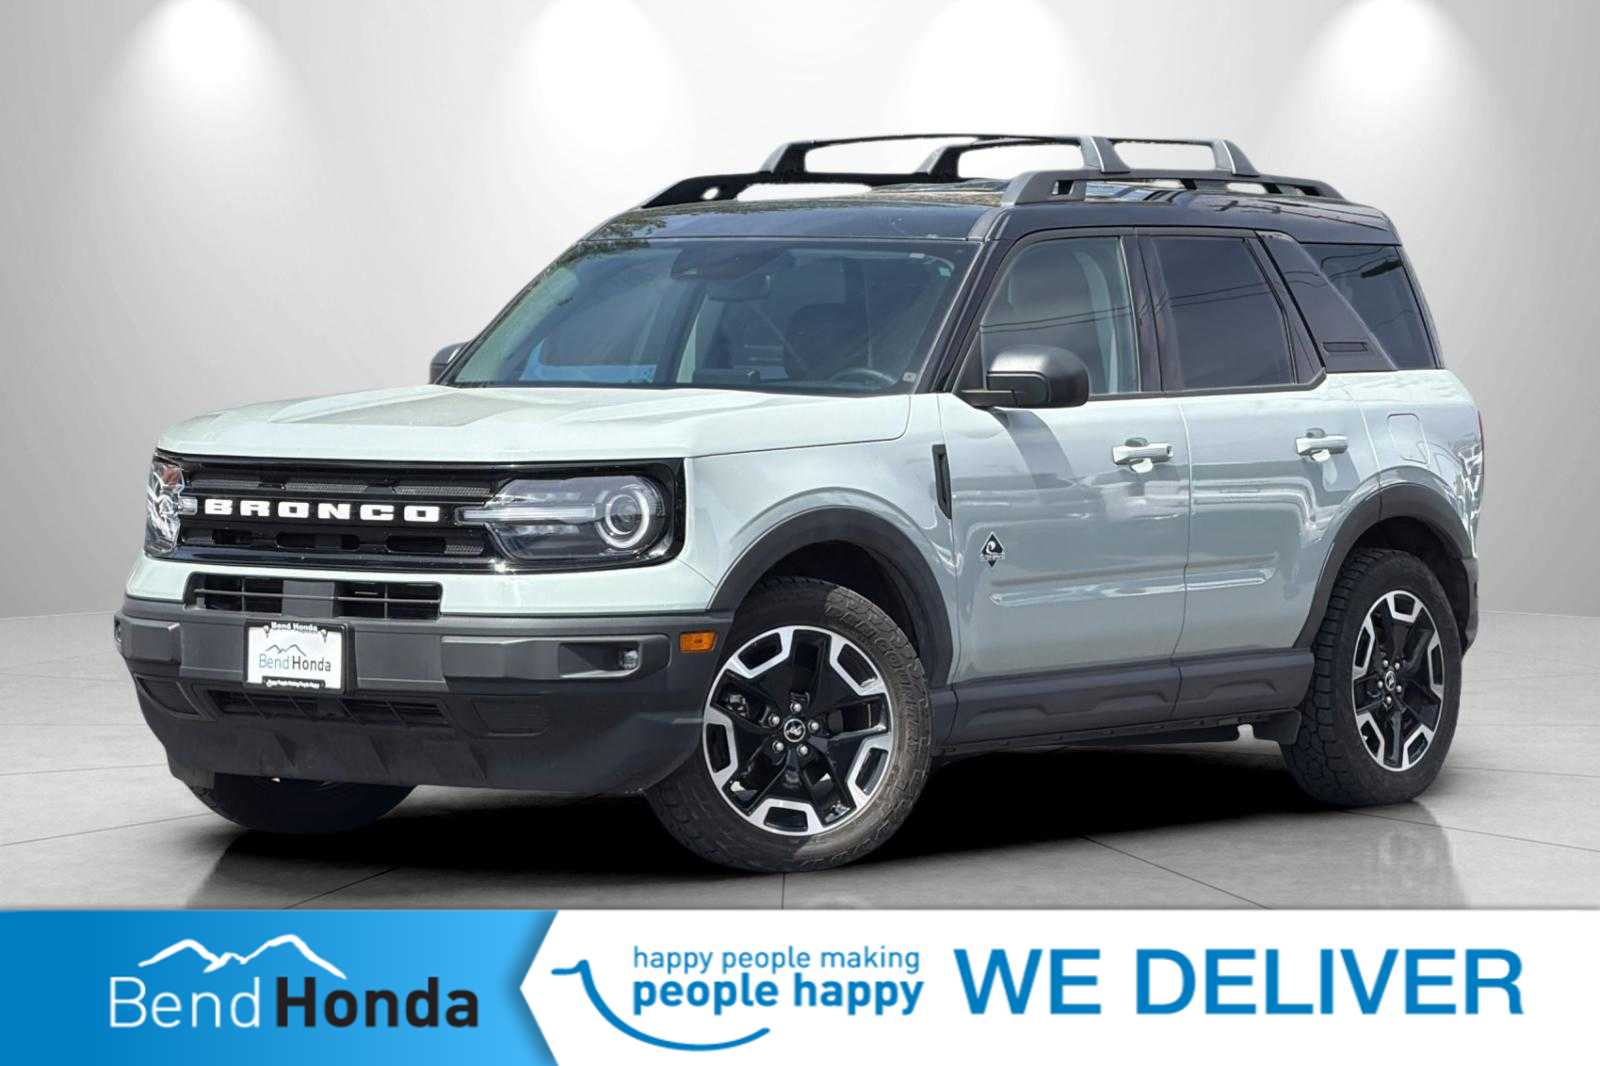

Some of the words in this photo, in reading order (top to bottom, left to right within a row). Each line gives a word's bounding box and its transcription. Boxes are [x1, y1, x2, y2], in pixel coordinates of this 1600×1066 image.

[204, 498, 440, 523] BRONCO
[271, 621, 291, 631] Bend
[293, 623, 318, 633] Honda
[258, 653, 290, 670] Bend
[292, 655, 332, 672] Honda
